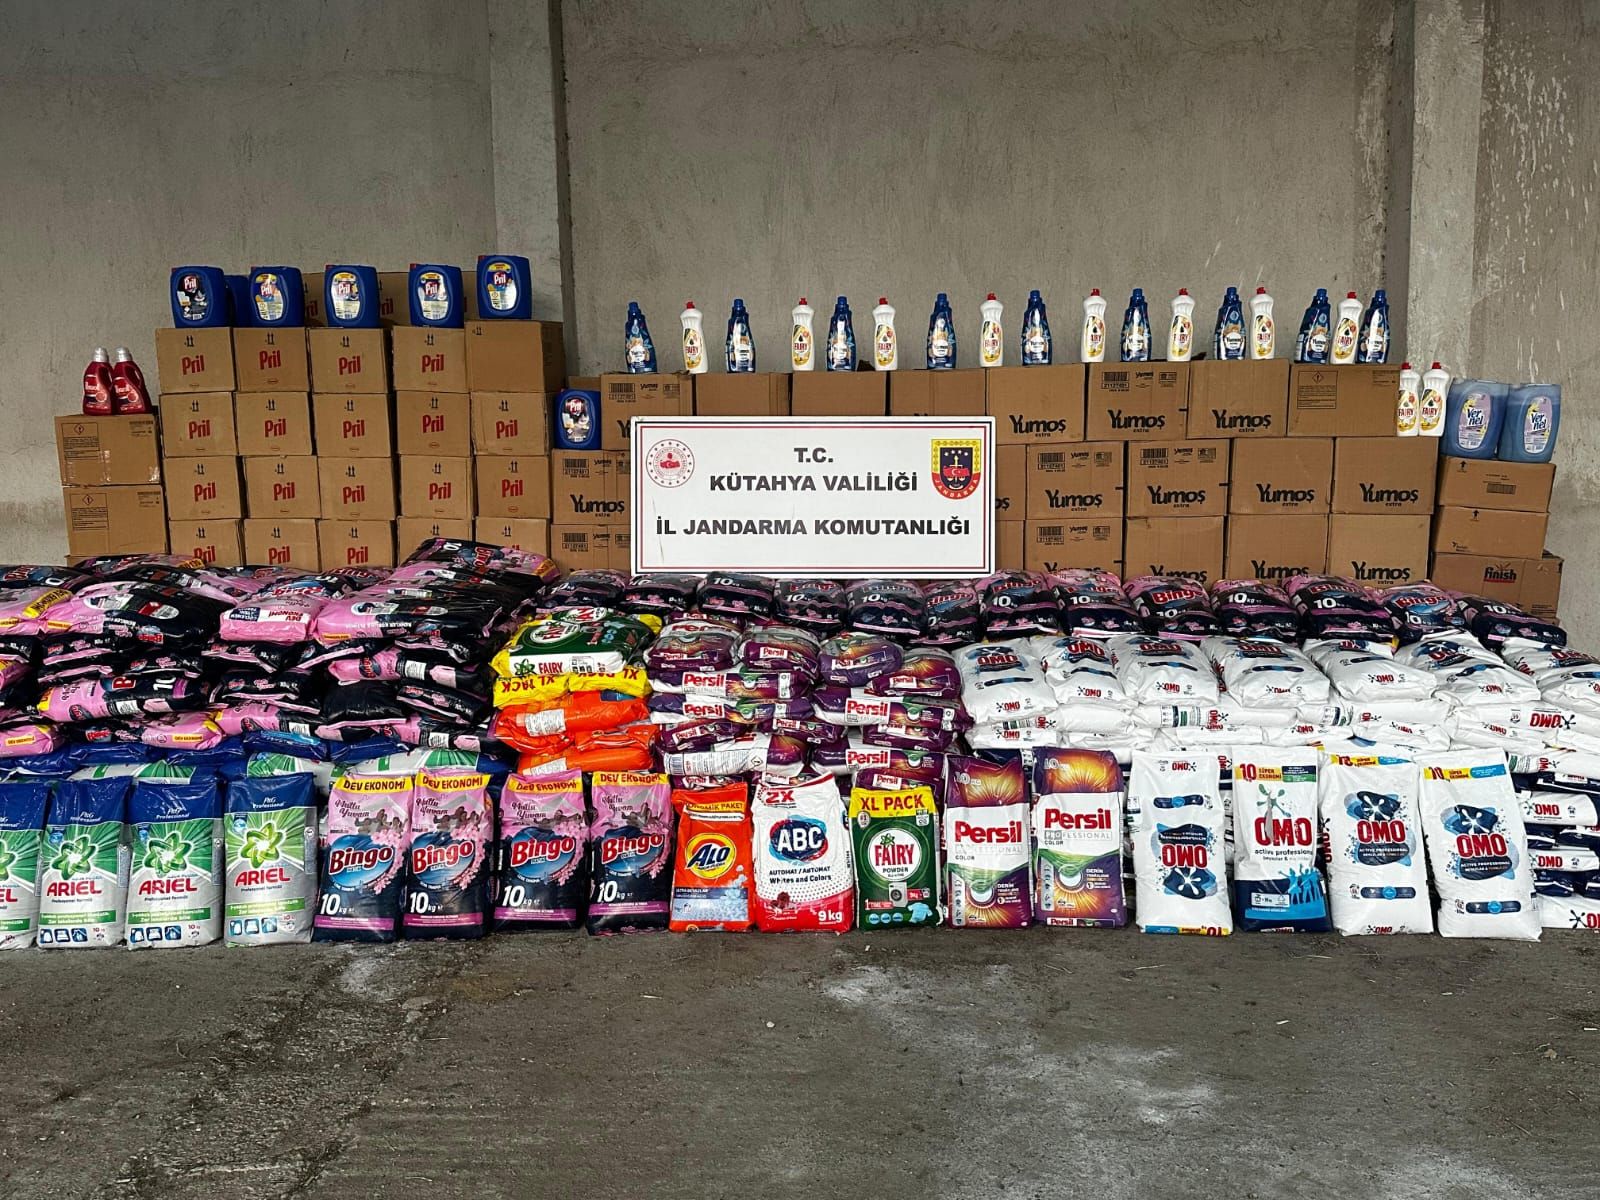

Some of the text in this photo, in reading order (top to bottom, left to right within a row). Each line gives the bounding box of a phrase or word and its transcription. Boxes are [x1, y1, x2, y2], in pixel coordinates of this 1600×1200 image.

[184, 276, 196, 290] Pril
[494, 273, 506, 286] Pril
[337, 282, 350, 295] Pril
[425, 282, 438, 295] Pril
[793, 343, 808, 351] FAIRY
[182, 355, 205, 375] Pril
[259, 351, 281, 369] Pril
[339, 356, 361, 375] Pril
[422, 354, 444, 373] Pril
[1108, 410, 1165, 429] Yumoş
[1212, 409, 1271, 429] Yumoş
[1422, 407, 1438, 416] FAIRY
[1467, 409, 1481, 418] Ver
[1531, 413, 1544, 423] Ver
[265, 419, 286, 437] Pril
[343, 420, 365, 438] Pril
[423, 415, 444, 433] Pril
[1009, 415, 1066, 434] Yumoş
[1469, 417, 1484, 425] nel
[1533, 421, 1546, 431] nel
[189, 420, 210, 439] Pril
[496, 420, 518, 439] Pril
[794, 448, 833, 463] T.C.
[502, 480, 523, 498] Pril
[710, 472, 917, 491] KÜTAHYA VALİLİĞİ
[194, 482, 216, 501] Pril
[274, 482, 295, 501] Pril
[343, 485, 365, 504] Pril
[430, 483, 451, 500] Pril
[1045, 489, 1103, 509] Yumoş
[1147, 485, 1206, 504] Yumoş
[1256, 483, 1315, 503] Yumoş
[1360, 483, 1419, 503] Yumoş
[570, 494, 625, 514] Yumoş
[657, 517, 969, 535] İL JANDARMA KOMUTANLIĞI
[194, 546, 215, 563] Pril
[269, 546, 290, 565] Pril
[347, 547, 368, 565] Pril
[1351, 561, 1410, 581] Yumoş
[1484, 567, 1516, 580] finish
[714, 577, 733, 586] 10
[863, 594, 880, 602] 10
[992, 596, 1011, 607] 10
[1070, 596, 1090, 604] 10
[1228, 593, 1247, 603] 10
[1314, 598, 1336, 609] 10
[1485, 604, 1506, 615] 10
[1406, 612, 1421, 624] 10
[762, 648, 784, 657] Persil
[1067, 641, 1105, 657] OMO
[539, 662, 563, 674] FAIRY
[977, 655, 1018, 665] OMO
[622, 669, 639, 680] XL
[683, 674, 726, 687] Persil
[1084, 689, 1101, 697] OMO
[1163, 683, 1180, 692] OMO
[684, 704, 724, 716] Persil
[848, 700, 889, 716] Persil
[1004, 702, 1020, 710] OMO
[776, 719, 797, 727] Persil
[1530, 713, 1562, 728] OMO
[1003, 731, 1020, 739] OMO
[848, 751, 889, 765] Persil
[1172, 762, 1188, 770] OMO
[601, 774, 660, 783] DEV EKONOMİ
[877, 776, 898, 784] Persil
[1240, 764, 1257, 781] 10
[344, 778, 405, 790] DEV EKONOMİ
[423, 775, 483, 788] DEV EKONOMİ
[536, 780, 577, 790] EKONOMİ
[766, 791, 794, 804] 2X
[861, 795, 925, 811] XL PACK
[1535, 804, 1560, 816] OMO
[1045, 808, 1111, 829] Persil
[777, 827, 823, 852] ABC
[955, 820, 1022, 843] Persil
[1045, 830, 1111, 840] PROFESSIONAL
[1254, 817, 1313, 846] OMO
[1357, 820, 1406, 843] OMO
[511, 837, 575, 867] Bingo
[601, 833, 663, 864] Bingo
[1456, 834, 1507, 858] OMO
[329, 847, 393, 875] Bingo
[412, 841, 474, 874] Bingo
[685, 844, 731, 869] ALO
[874, 844, 915, 866] FAIRY
[1162, 845, 1208, 868] OMO
[1537, 856, 1563, 868] OMO
[235, 867, 291, 887] ARIEL
[769, 867, 797, 875] AUTOMAT
[769, 876, 794, 884] Whites
[810, 874, 831, 882] Colors
[47, 880, 102, 896] ARIEL
[139, 878, 197, 895] ARIEL
[597, 881, 625, 902] 10 kg
[320, 893, 347, 914] 10 kg
[409, 892, 436, 914] 10 kg
[502, 885, 532, 907] 10 kg
[818, 910, 843, 923] 9 kg
[1373, 926, 1392, 934] OMO
